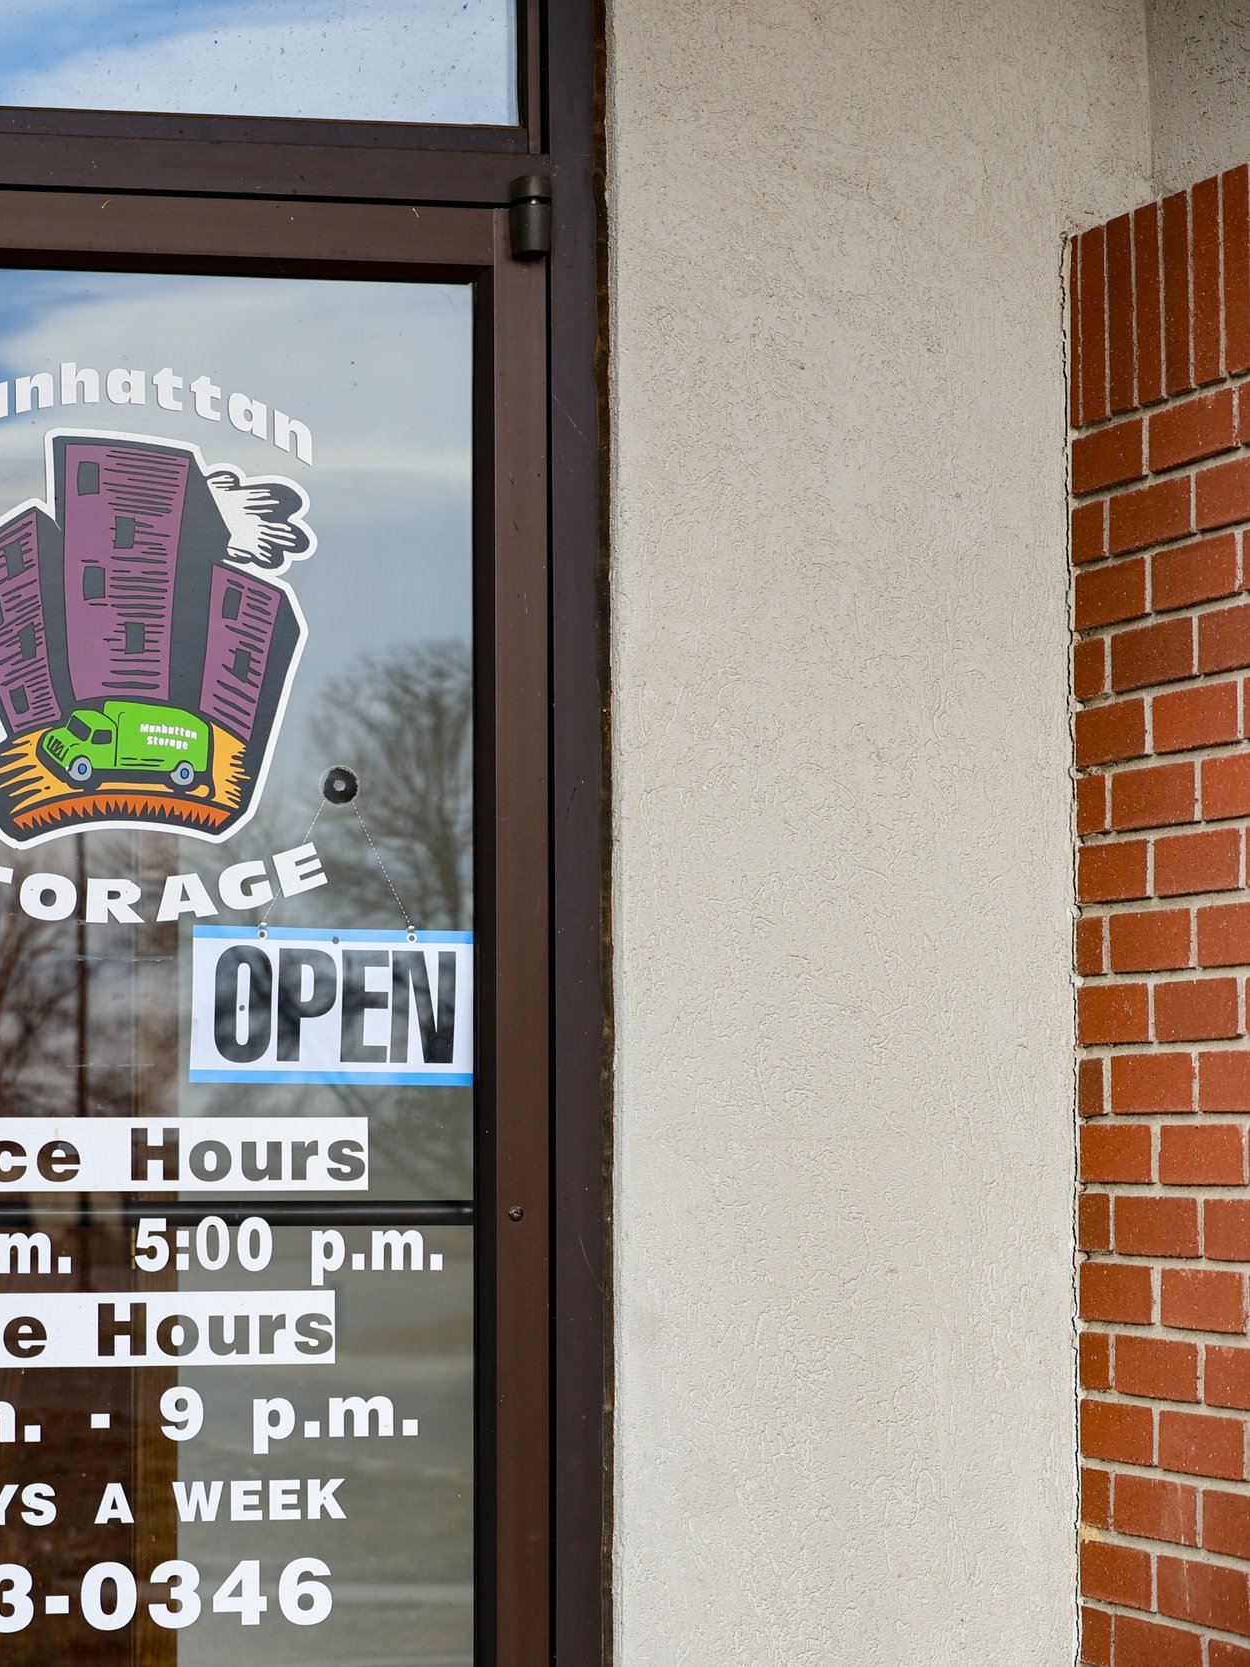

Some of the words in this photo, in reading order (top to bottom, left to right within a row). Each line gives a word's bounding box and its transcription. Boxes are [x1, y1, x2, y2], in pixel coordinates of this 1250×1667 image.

[140, 723, 197, 739] Manhattan
[147, 736, 188, 749] Storage
[213, 945, 457, 1064] OPEN
[130, 1127, 367, 1182] Hours
[134, 1216, 273, 1271] 5:00
[311, 1224, 444, 1285] p.m.
[97, 1302, 334, 1357] Hours
[159, 1386, 204, 1442] 9
[253, 1395, 419, 1455] p.m.
[94, 1482, 134, 1525] A
[172, 1478, 347, 1523] WEEK
